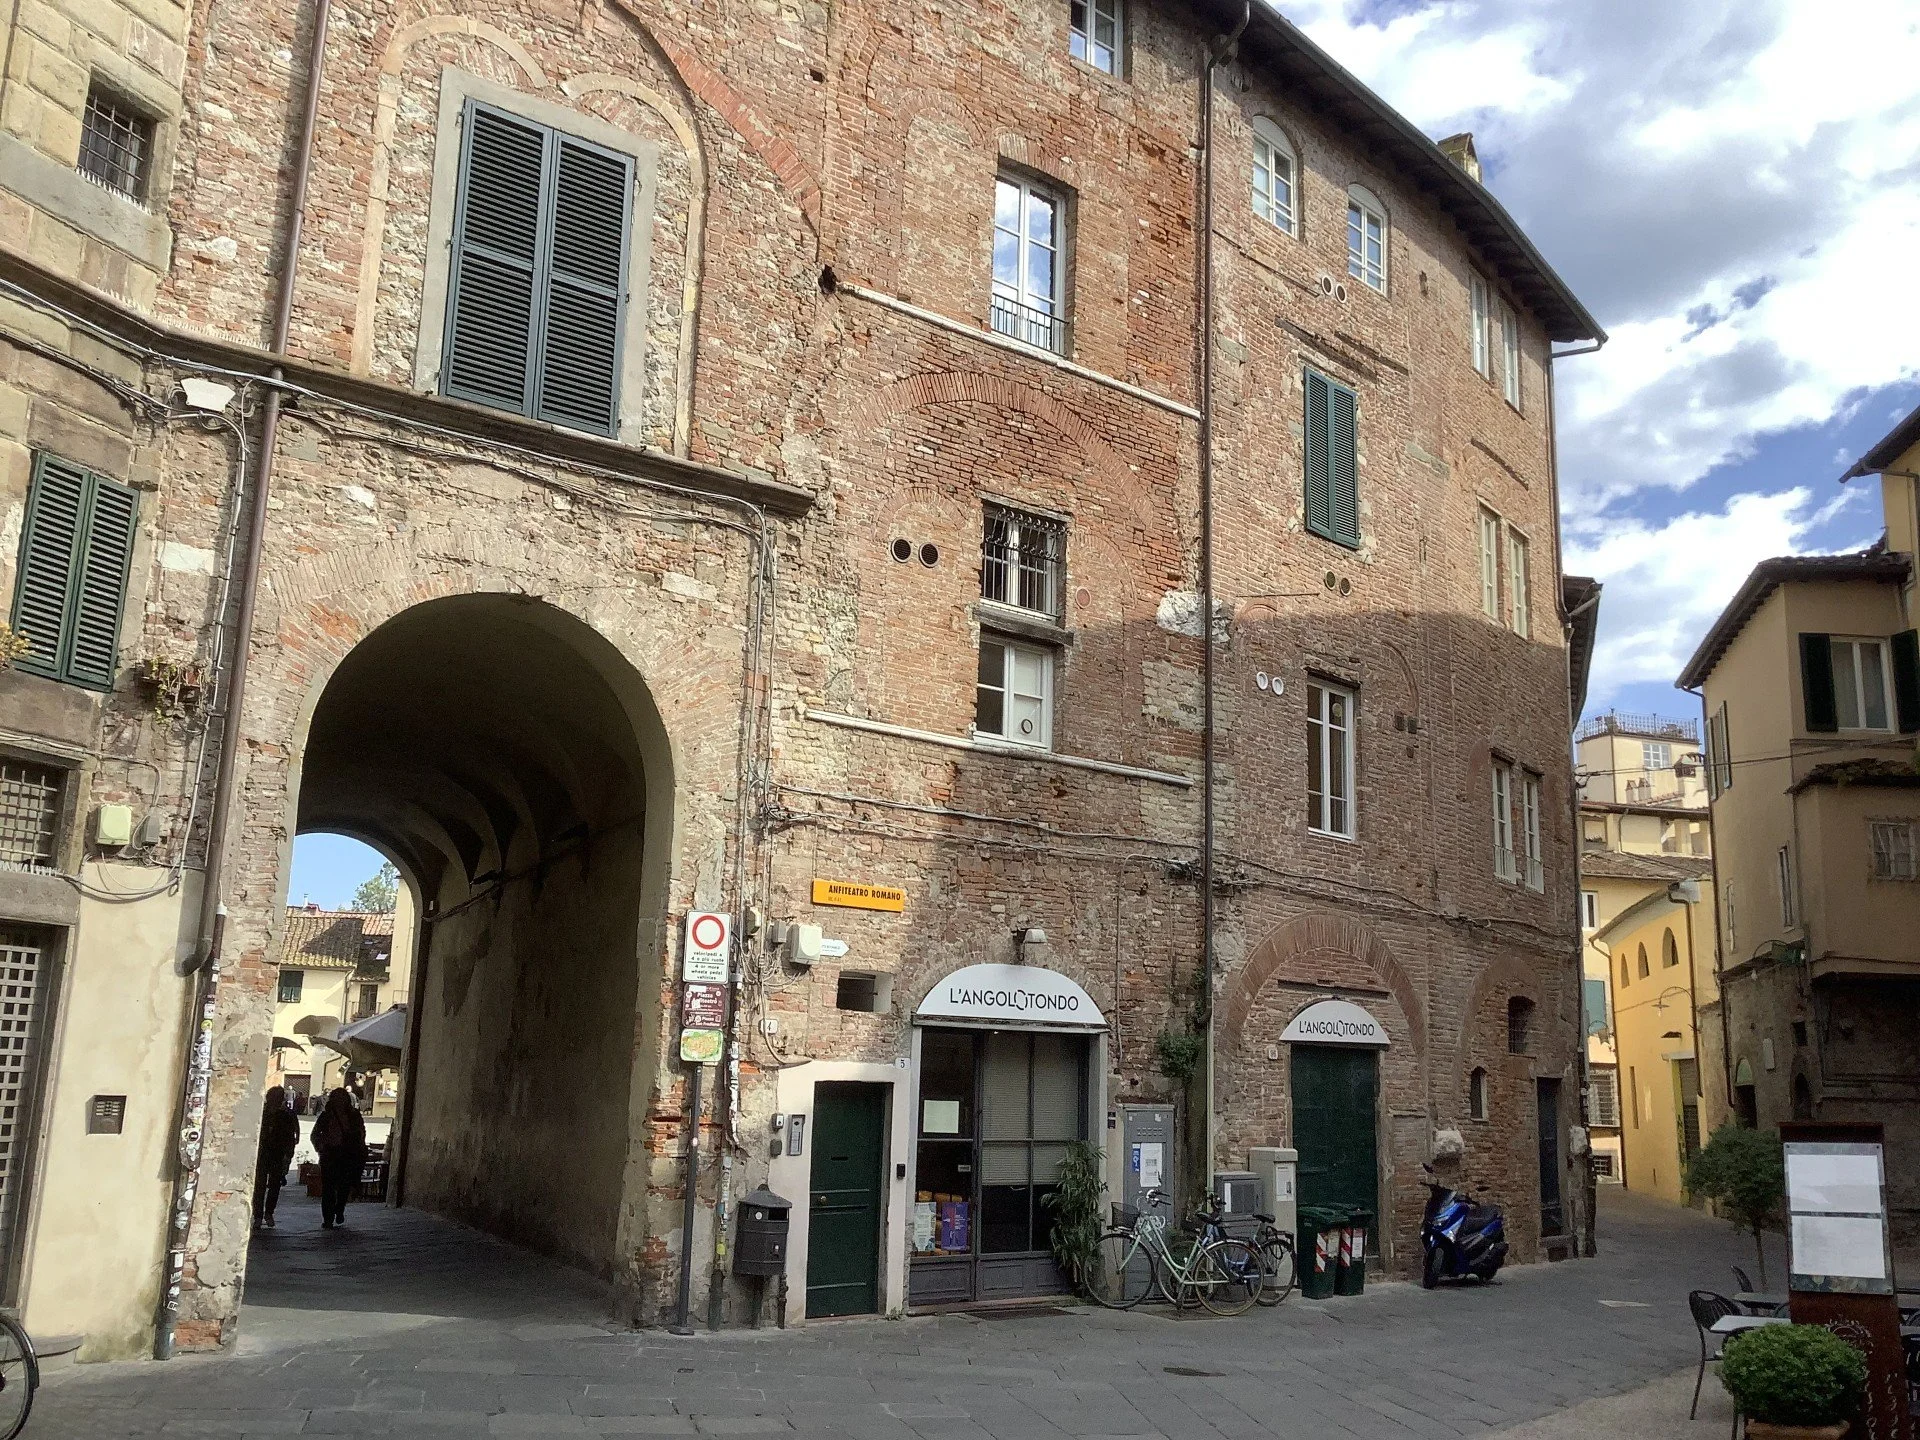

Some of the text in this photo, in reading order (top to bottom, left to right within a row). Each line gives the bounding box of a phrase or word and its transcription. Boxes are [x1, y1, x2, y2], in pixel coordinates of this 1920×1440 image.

[828, 885, 901, 901] ANFITEATRO ROMANO
[949, 987, 1079, 1011] L'ANGOLOTONDO
[1299, 1020, 1375, 1037] L'ANGOLOTONDO
